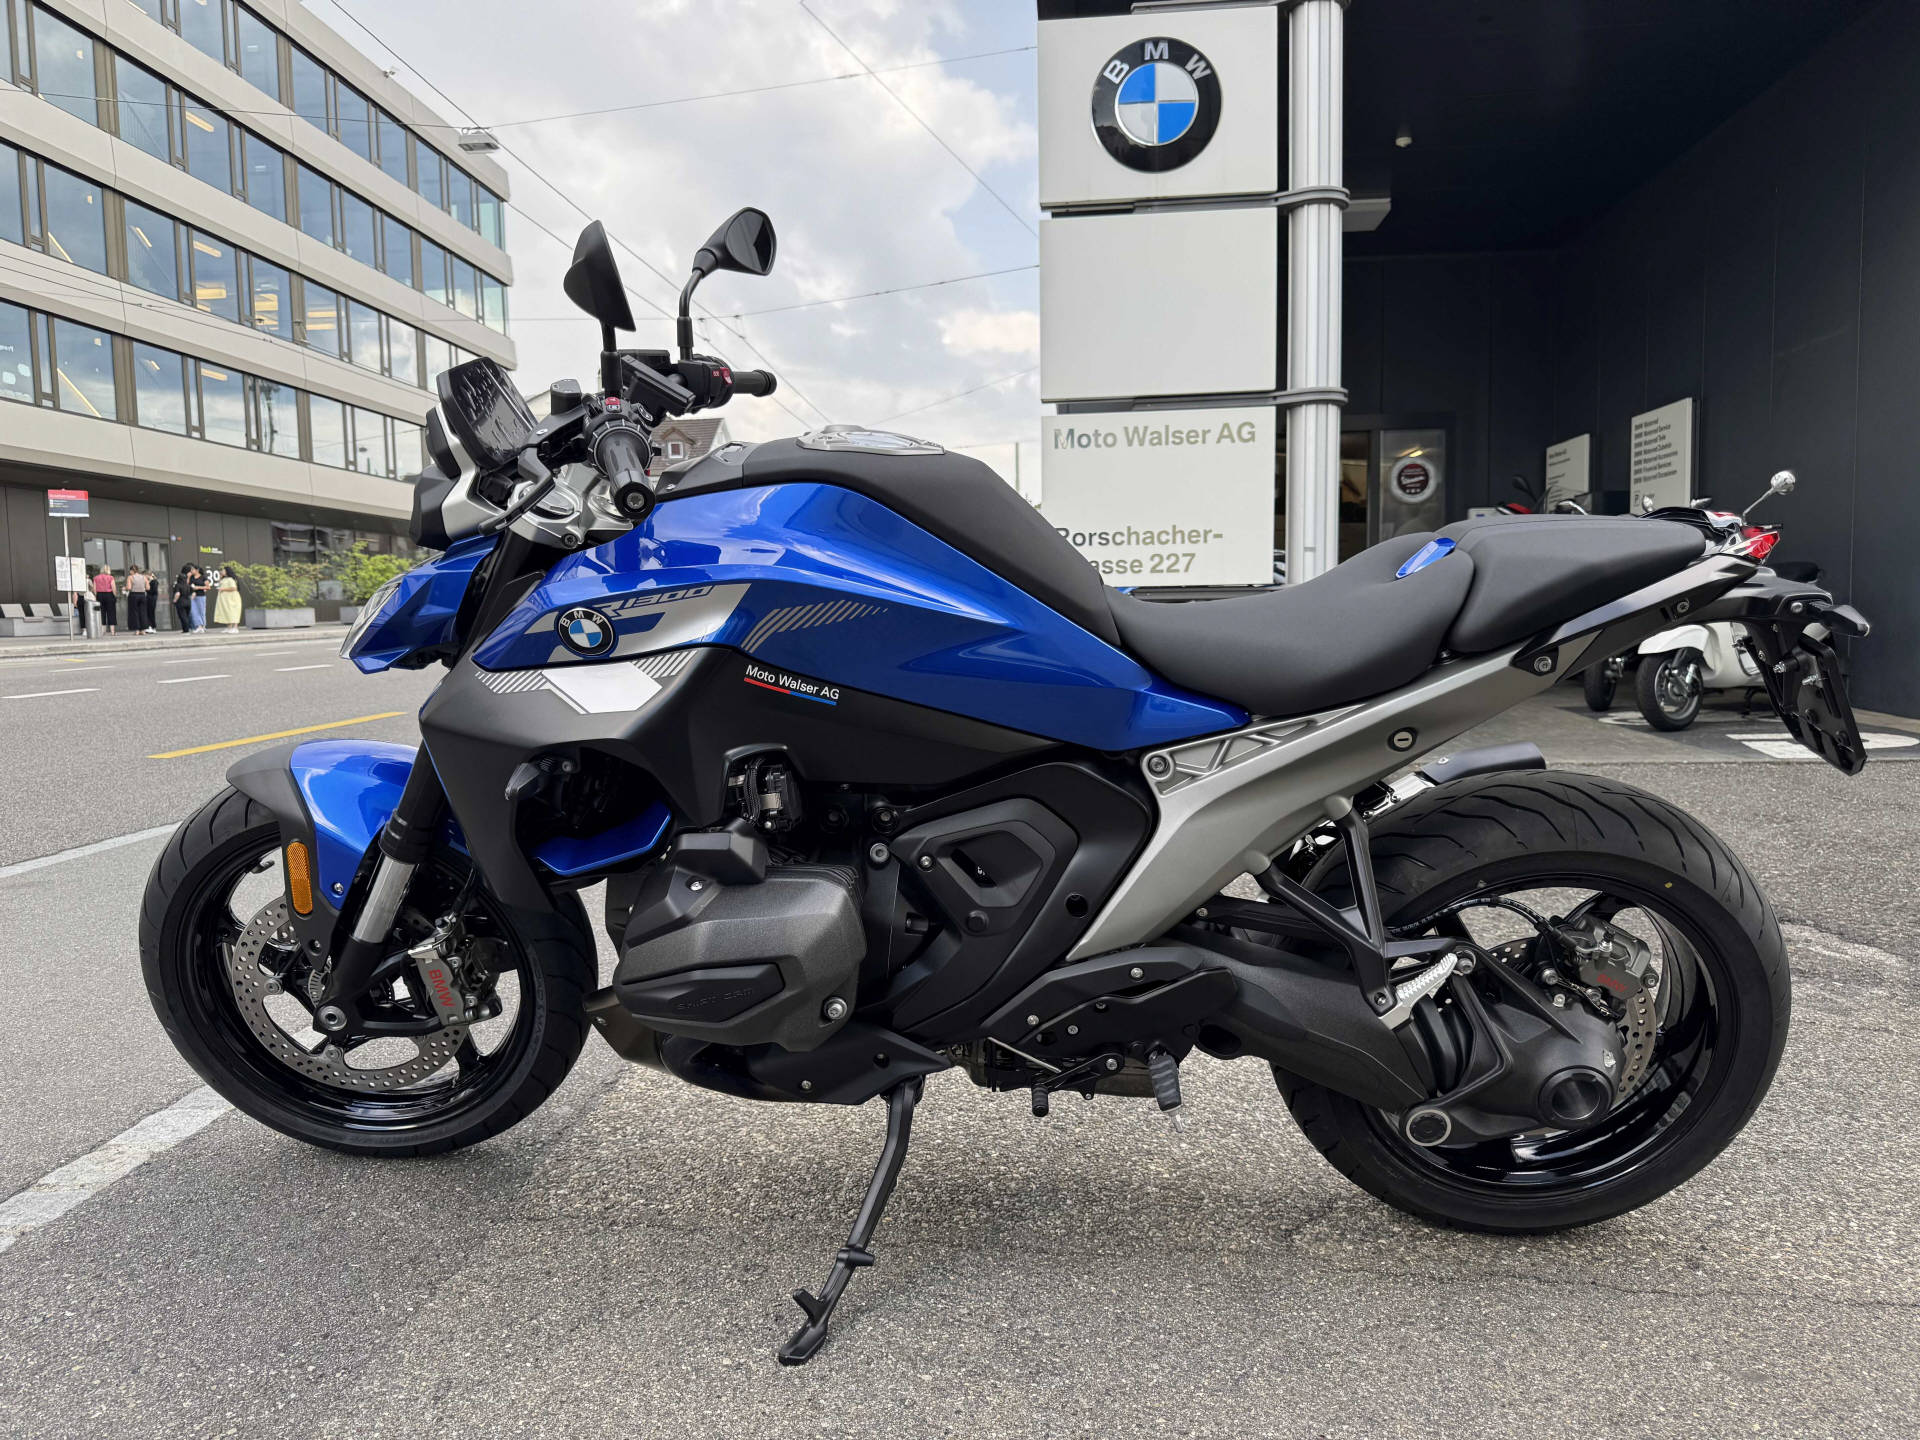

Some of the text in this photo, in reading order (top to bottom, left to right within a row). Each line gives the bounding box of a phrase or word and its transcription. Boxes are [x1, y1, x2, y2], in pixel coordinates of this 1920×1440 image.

[1103, 39, 1211, 85] BMW
[1054, 421, 1256, 449] Moto Walser AG
[1089, 553, 1196, 574] asse 227
[560, 610, 604, 628] BMW
[745, 664, 840, 700] Moto Walser AG
[428, 968, 457, 1007] BMW
[1597, 973, 1627, 993] BMW
